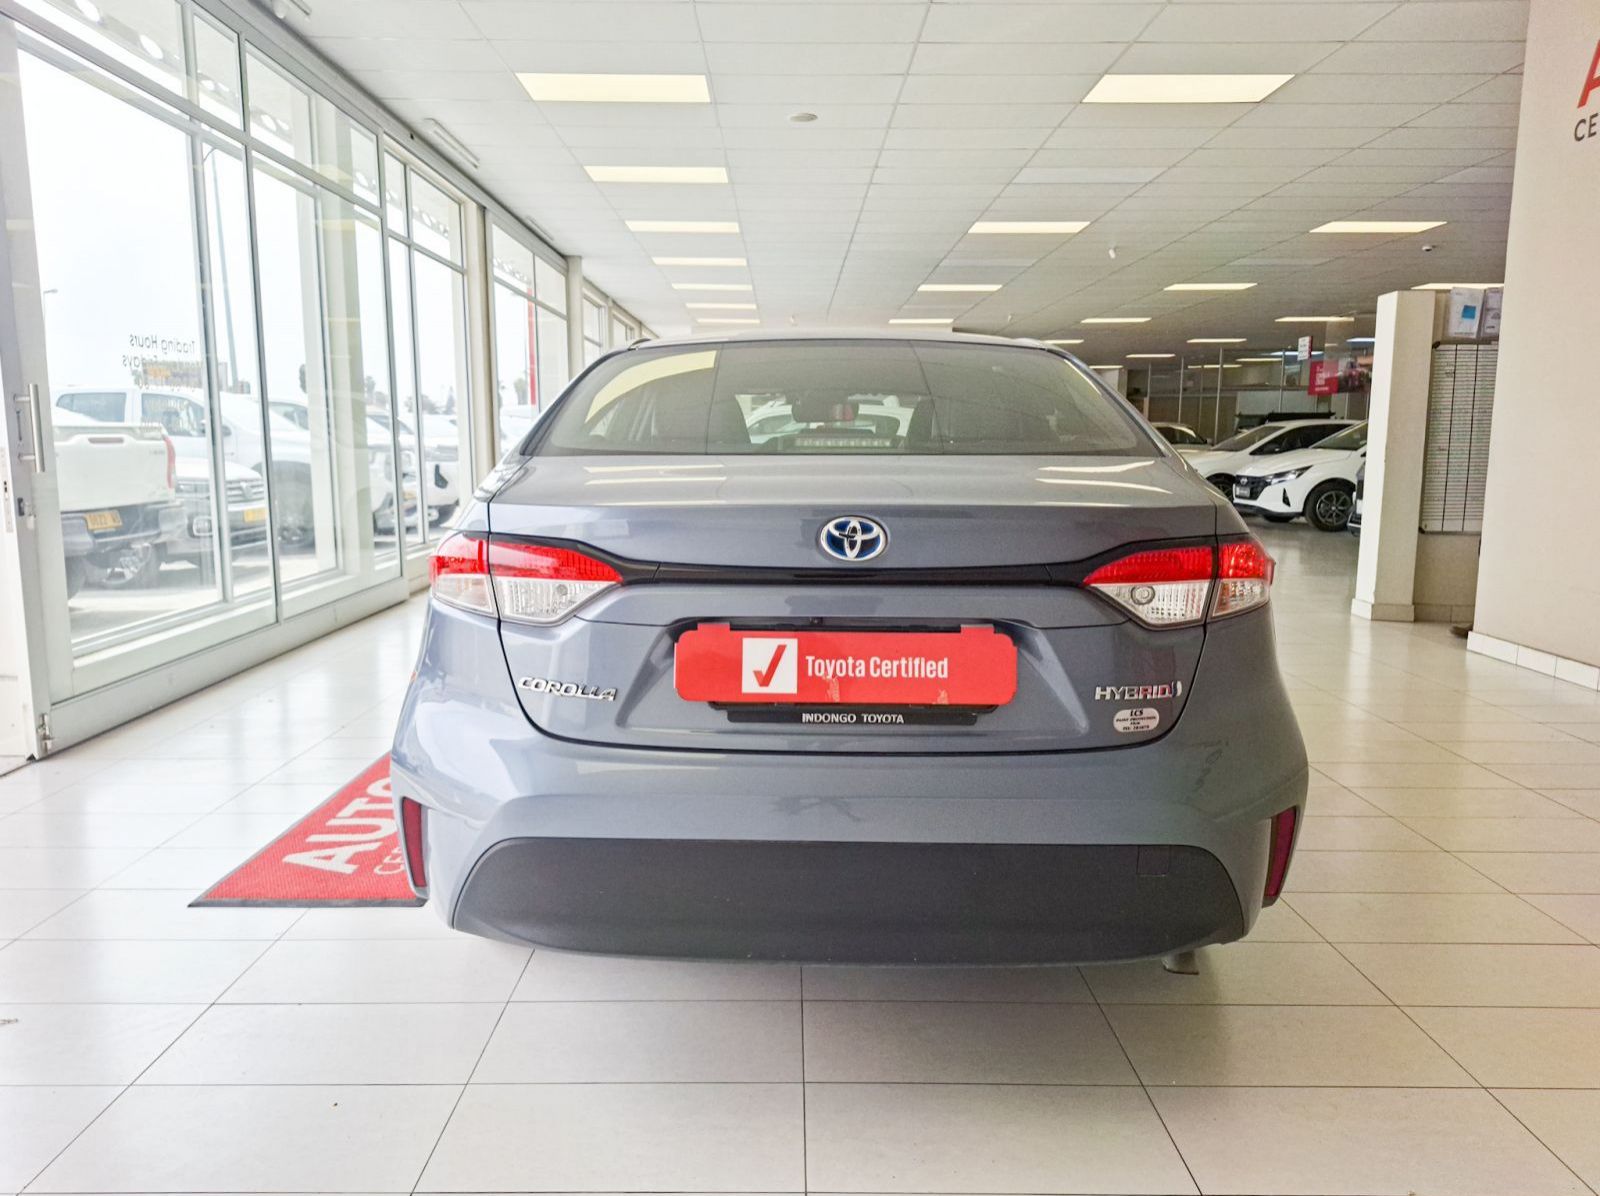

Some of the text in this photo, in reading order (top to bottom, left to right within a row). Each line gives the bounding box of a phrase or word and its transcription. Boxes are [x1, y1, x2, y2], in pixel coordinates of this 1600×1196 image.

[805, 655, 949, 679] Toyota Certified
[518, 676, 618, 702] COROLLA
[1094, 684, 1173, 701] HYBRID
[801, 712, 905, 724] INDONGO TOYOTA
